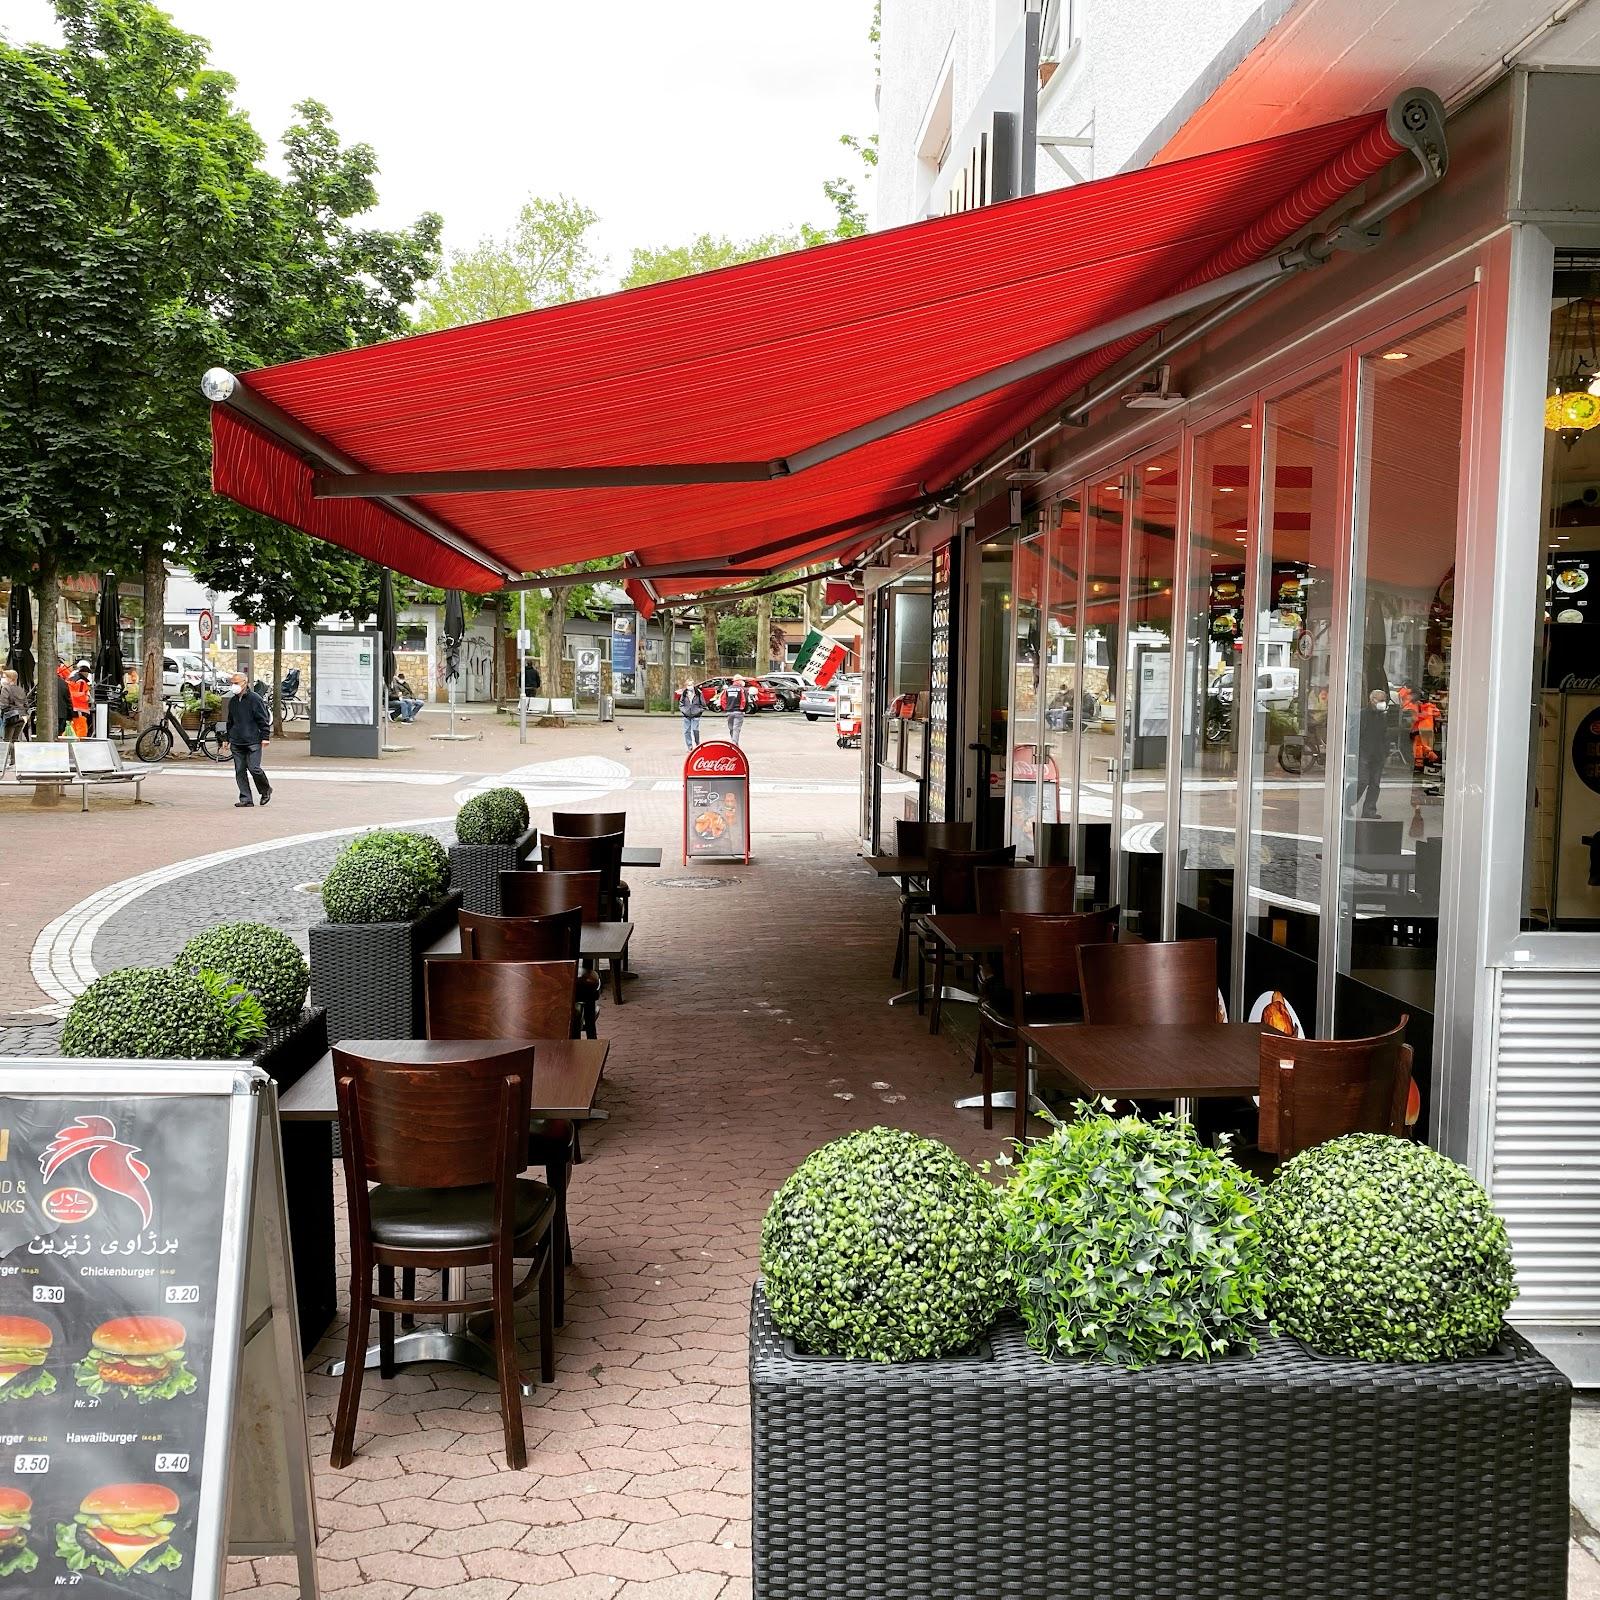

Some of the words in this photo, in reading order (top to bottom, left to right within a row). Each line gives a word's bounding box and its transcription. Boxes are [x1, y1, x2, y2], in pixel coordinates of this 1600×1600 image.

[693, 756, 738, 772] Coca-Cola
[17, 1180, 26, 1194] &
[80, 1266, 155, 1277] Chickenburger
[35, 1288, 63, 1301] 3.30
[168, 1287, 197, 1301] 3.20
[74, 1400, 86, 1408] Nr.
[88, 1400, 99, 1408] 21
[66, 1432, 138, 1445] Hawaiiburger
[16, 1457, 48, 1471] 3.50
[157, 1456, 188, 1469] 3.40
[54, 1575, 67, 1585] Nr.
[69, 1575, 81, 1585] 27
